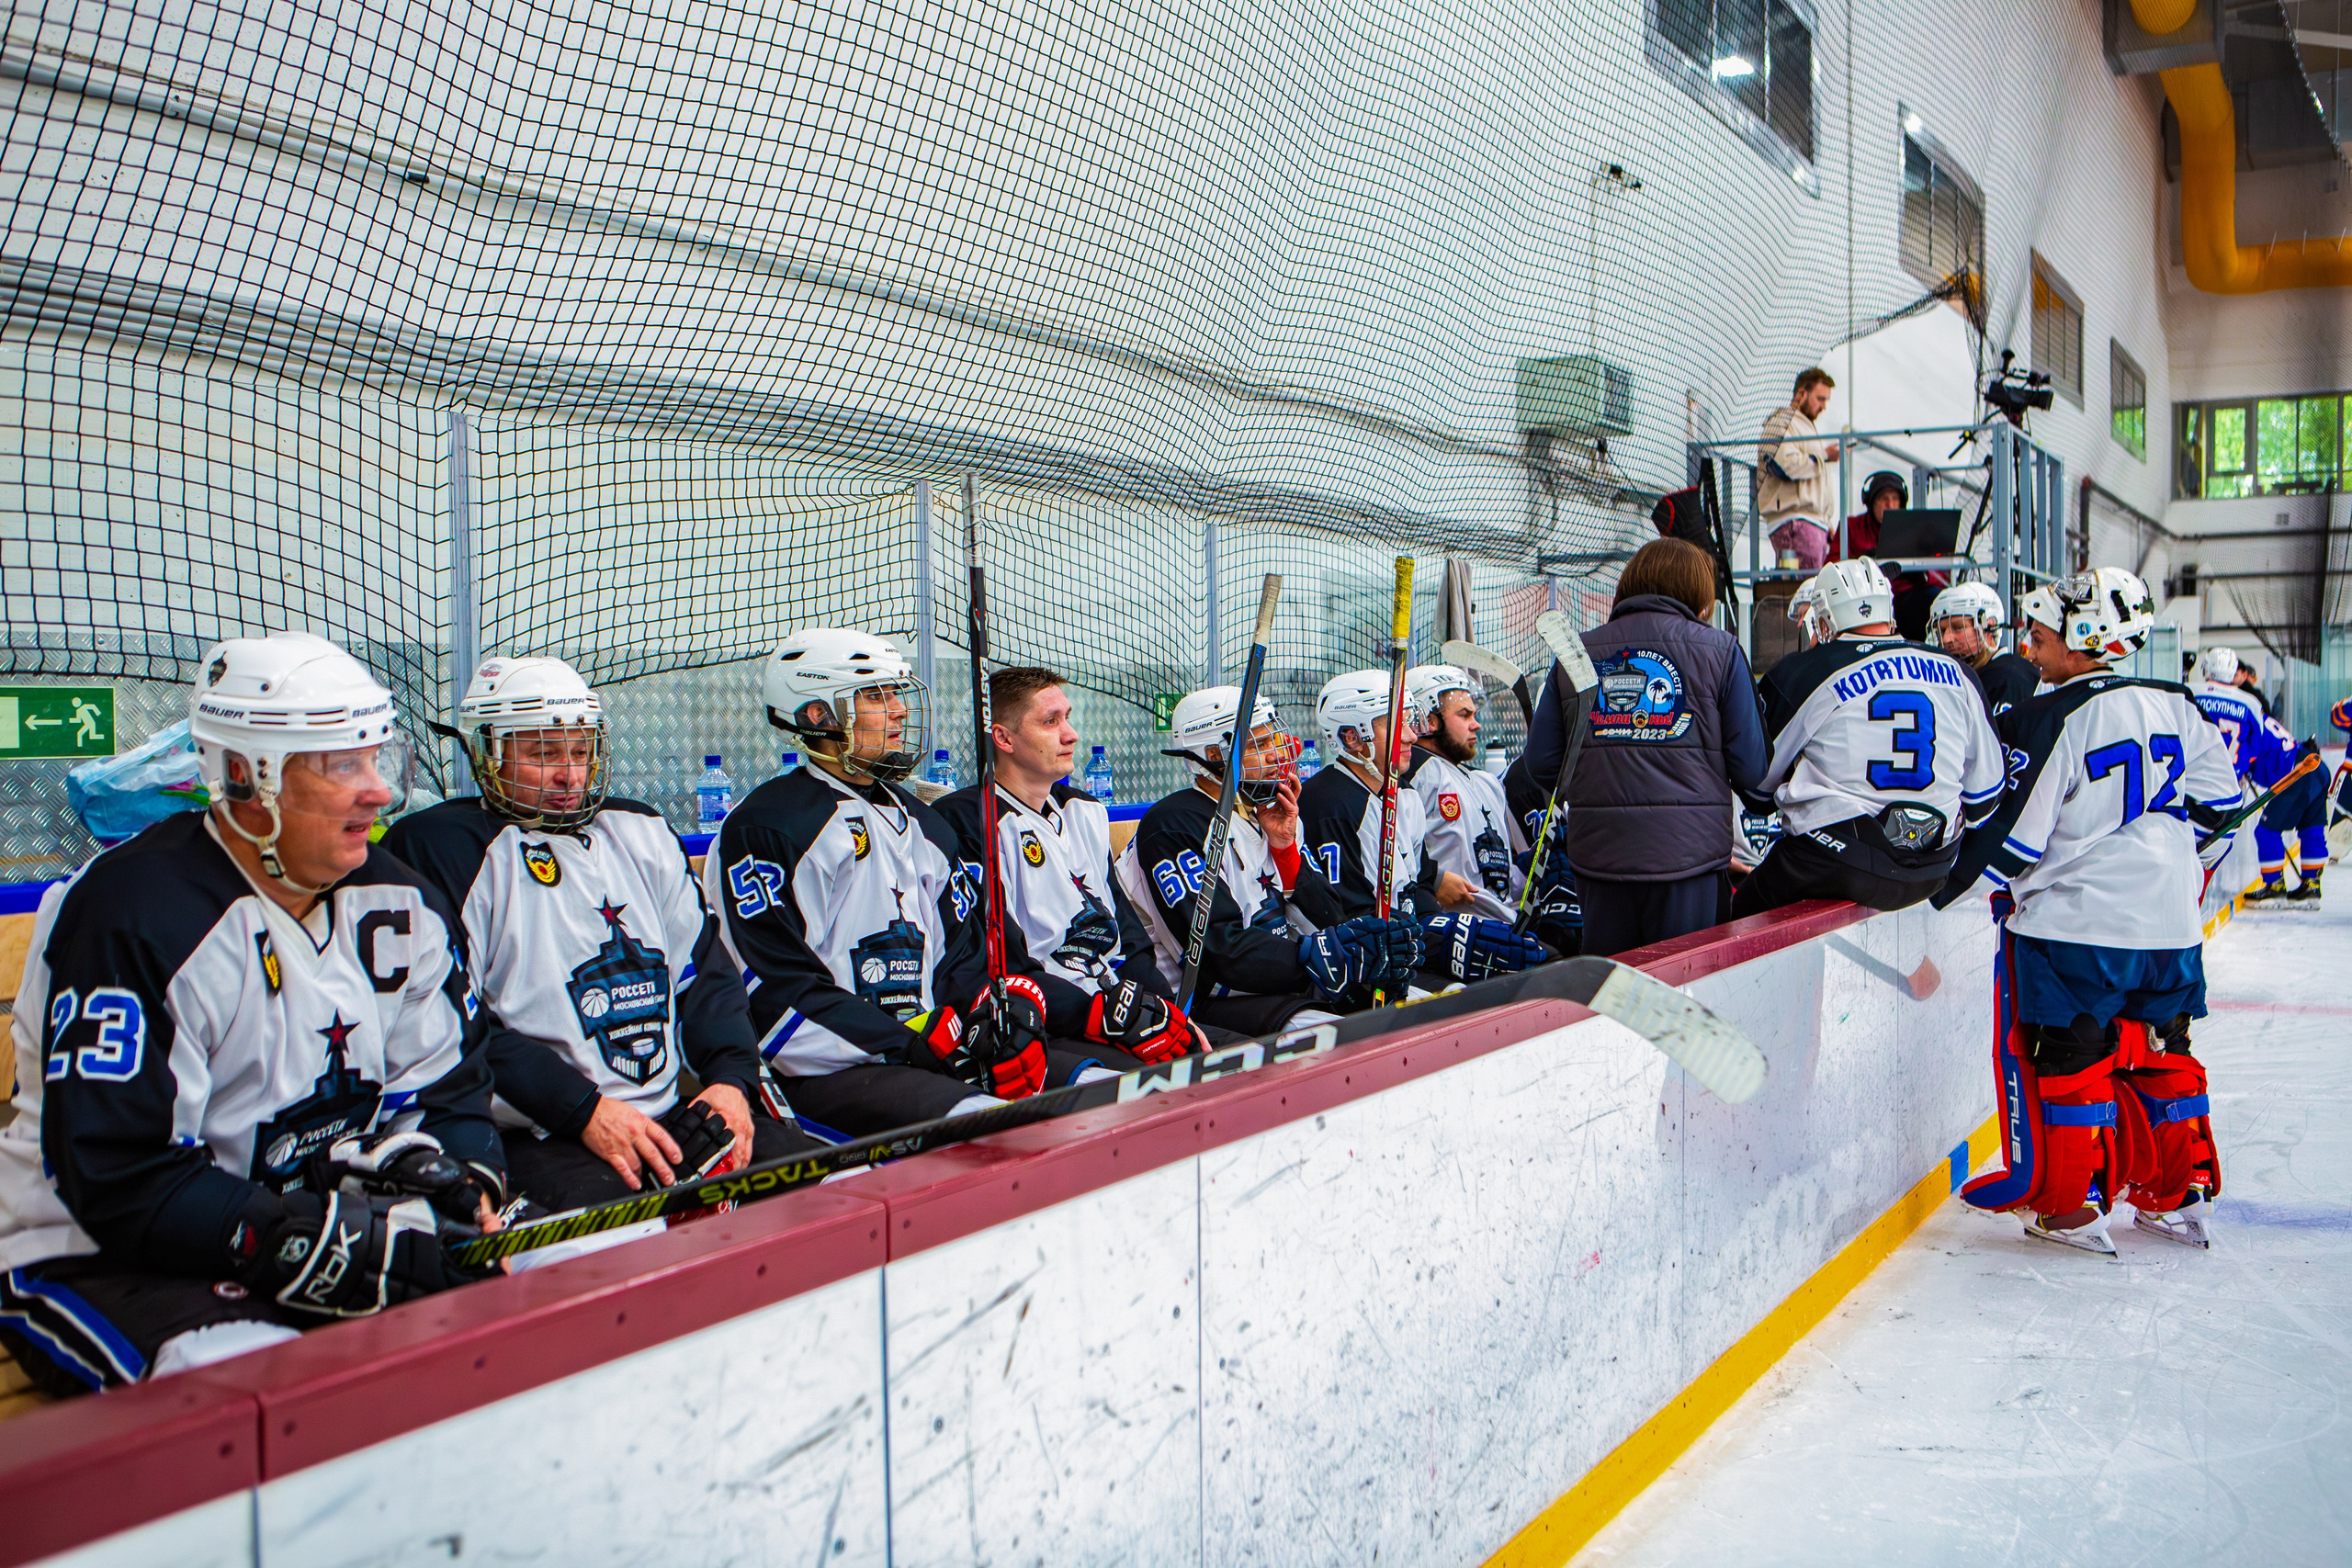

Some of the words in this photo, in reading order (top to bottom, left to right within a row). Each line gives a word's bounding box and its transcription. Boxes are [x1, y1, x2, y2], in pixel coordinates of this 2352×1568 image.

[546, 697, 585, 705] BAUER
[797, 671, 830, 681] EASTON
[979, 656, 993, 734] EASTON
[1661, 659, 1682, 695] ВМЕСТЕ
[1832, 655, 1962, 703] KOTRYUMIN
[198, 704, 245, 720] BAUER
[351, 703, 388, 718] BAUER
[1184, 721, 1213, 734] BAUER
[1632, 728, 1668, 740] 2023
[2197, 698, 2246, 718] ПОКУПНЫЙ
[1865, 690, 1937, 792] 3
[2085, 733, 2189, 828] 72
[1382, 761, 1398, 886] JETSPEED
[1152, 848, 1206, 909] 68
[1185, 810, 1228, 966] BAUER
[356, 909, 412, 994] C
[1452, 912, 1473, 980] BAUE
[45, 986, 146, 1083] 23
[1116, 1023, 1339, 1105] CCM
[2007, 1071, 2022, 1165] TRUE
[697, 1158, 831, 1204] TACKS
